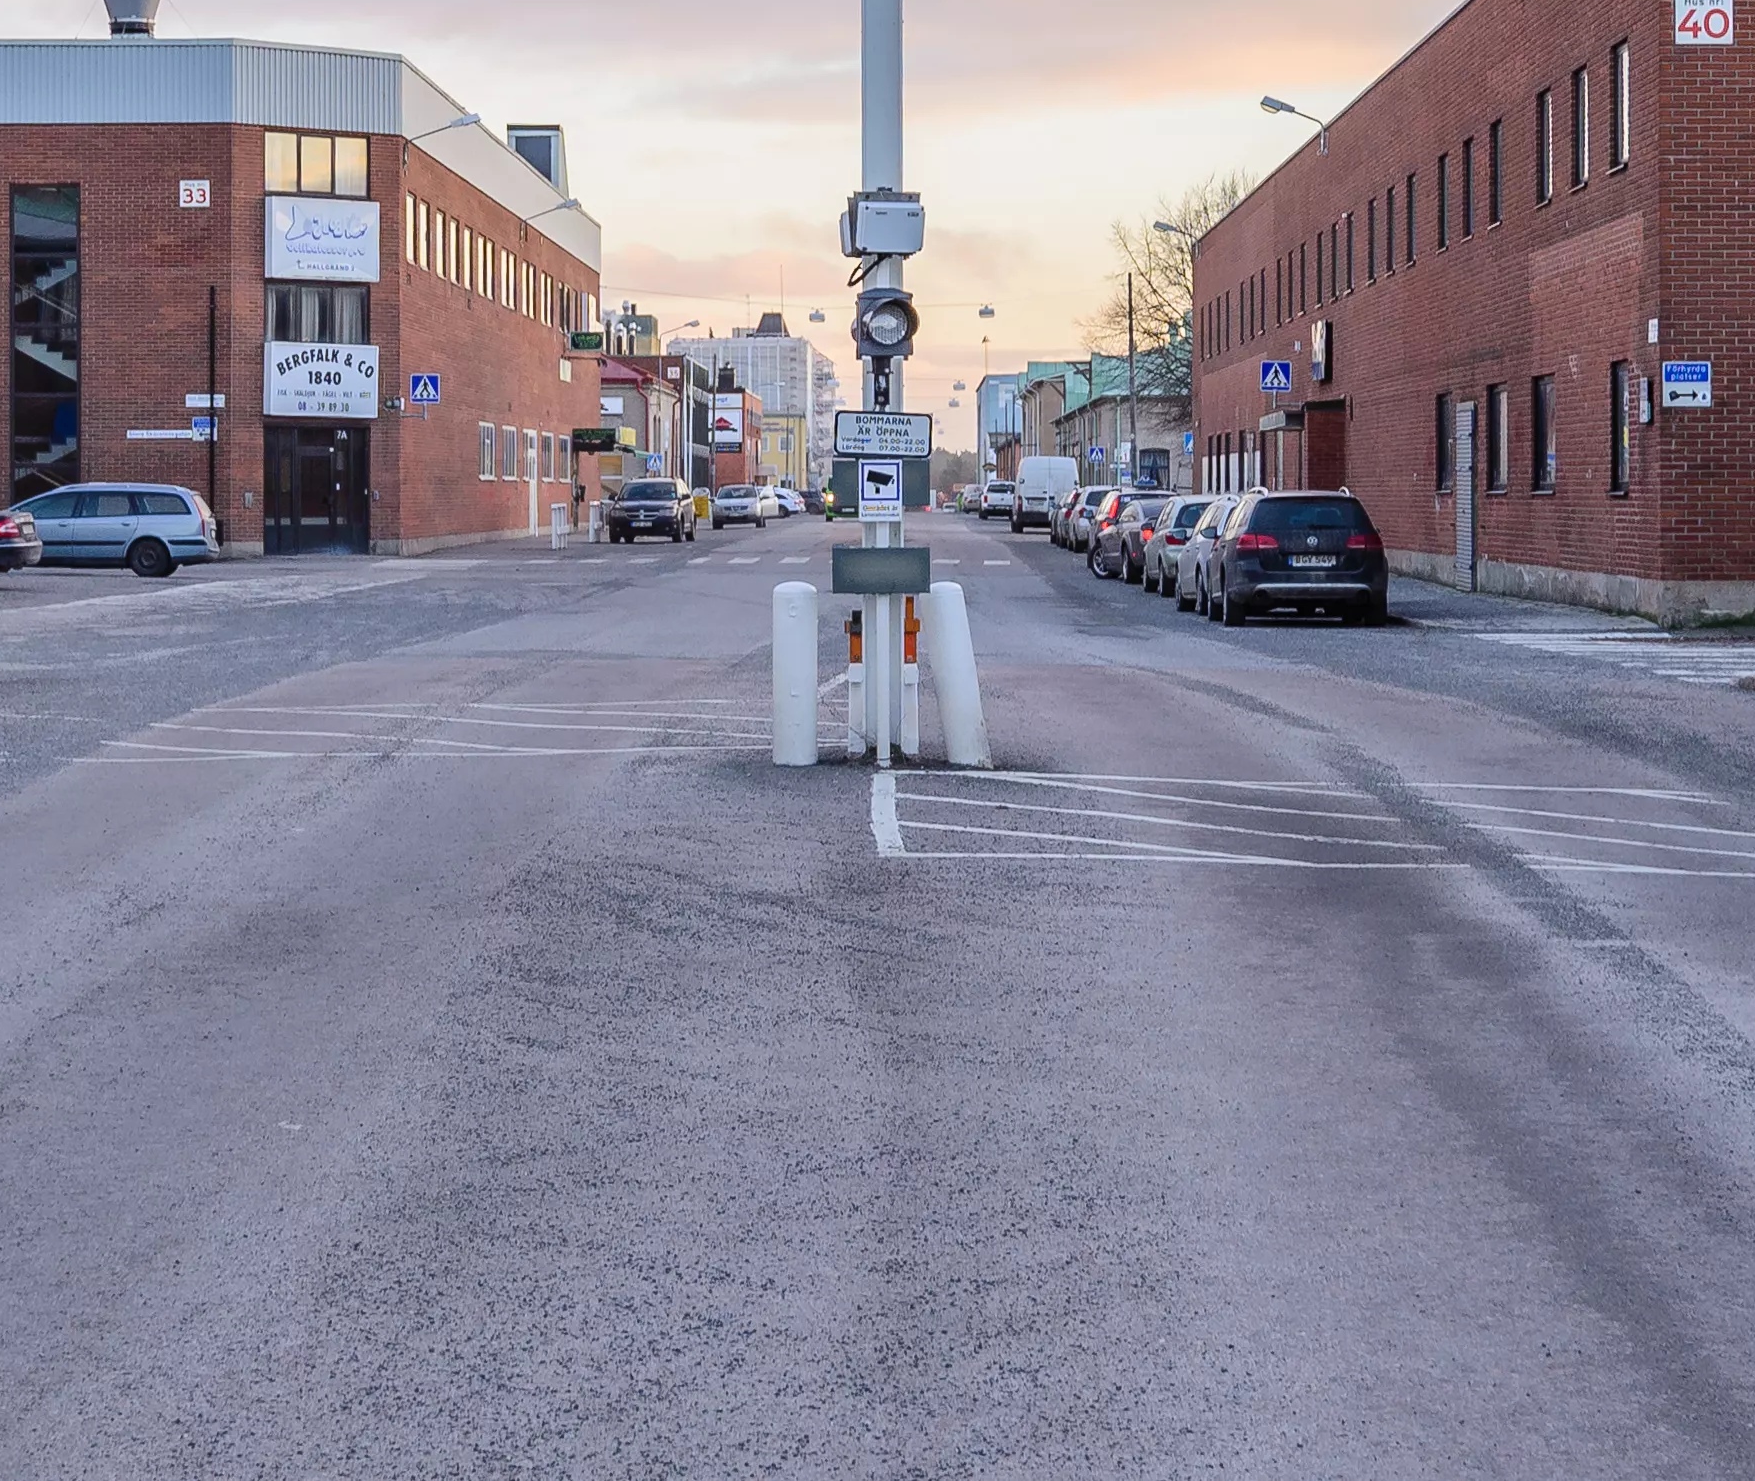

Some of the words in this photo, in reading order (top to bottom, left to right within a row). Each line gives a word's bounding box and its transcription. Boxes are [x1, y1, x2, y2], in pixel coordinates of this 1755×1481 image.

[1677, 8, 1729, 39] 40
[183, 188, 206, 204] 33
[276, 349, 339, 376] BERGFALK
[344, 353, 352, 368] &
[358, 361, 374, 378] CO
[309, 371, 341, 385] 1840
[856, 416, 911, 426] BOMMARNA
[337, 430, 347, 439] 7A
[858, 425, 870, 435] ÄR
[876, 426, 909, 437] ÖPPNA
